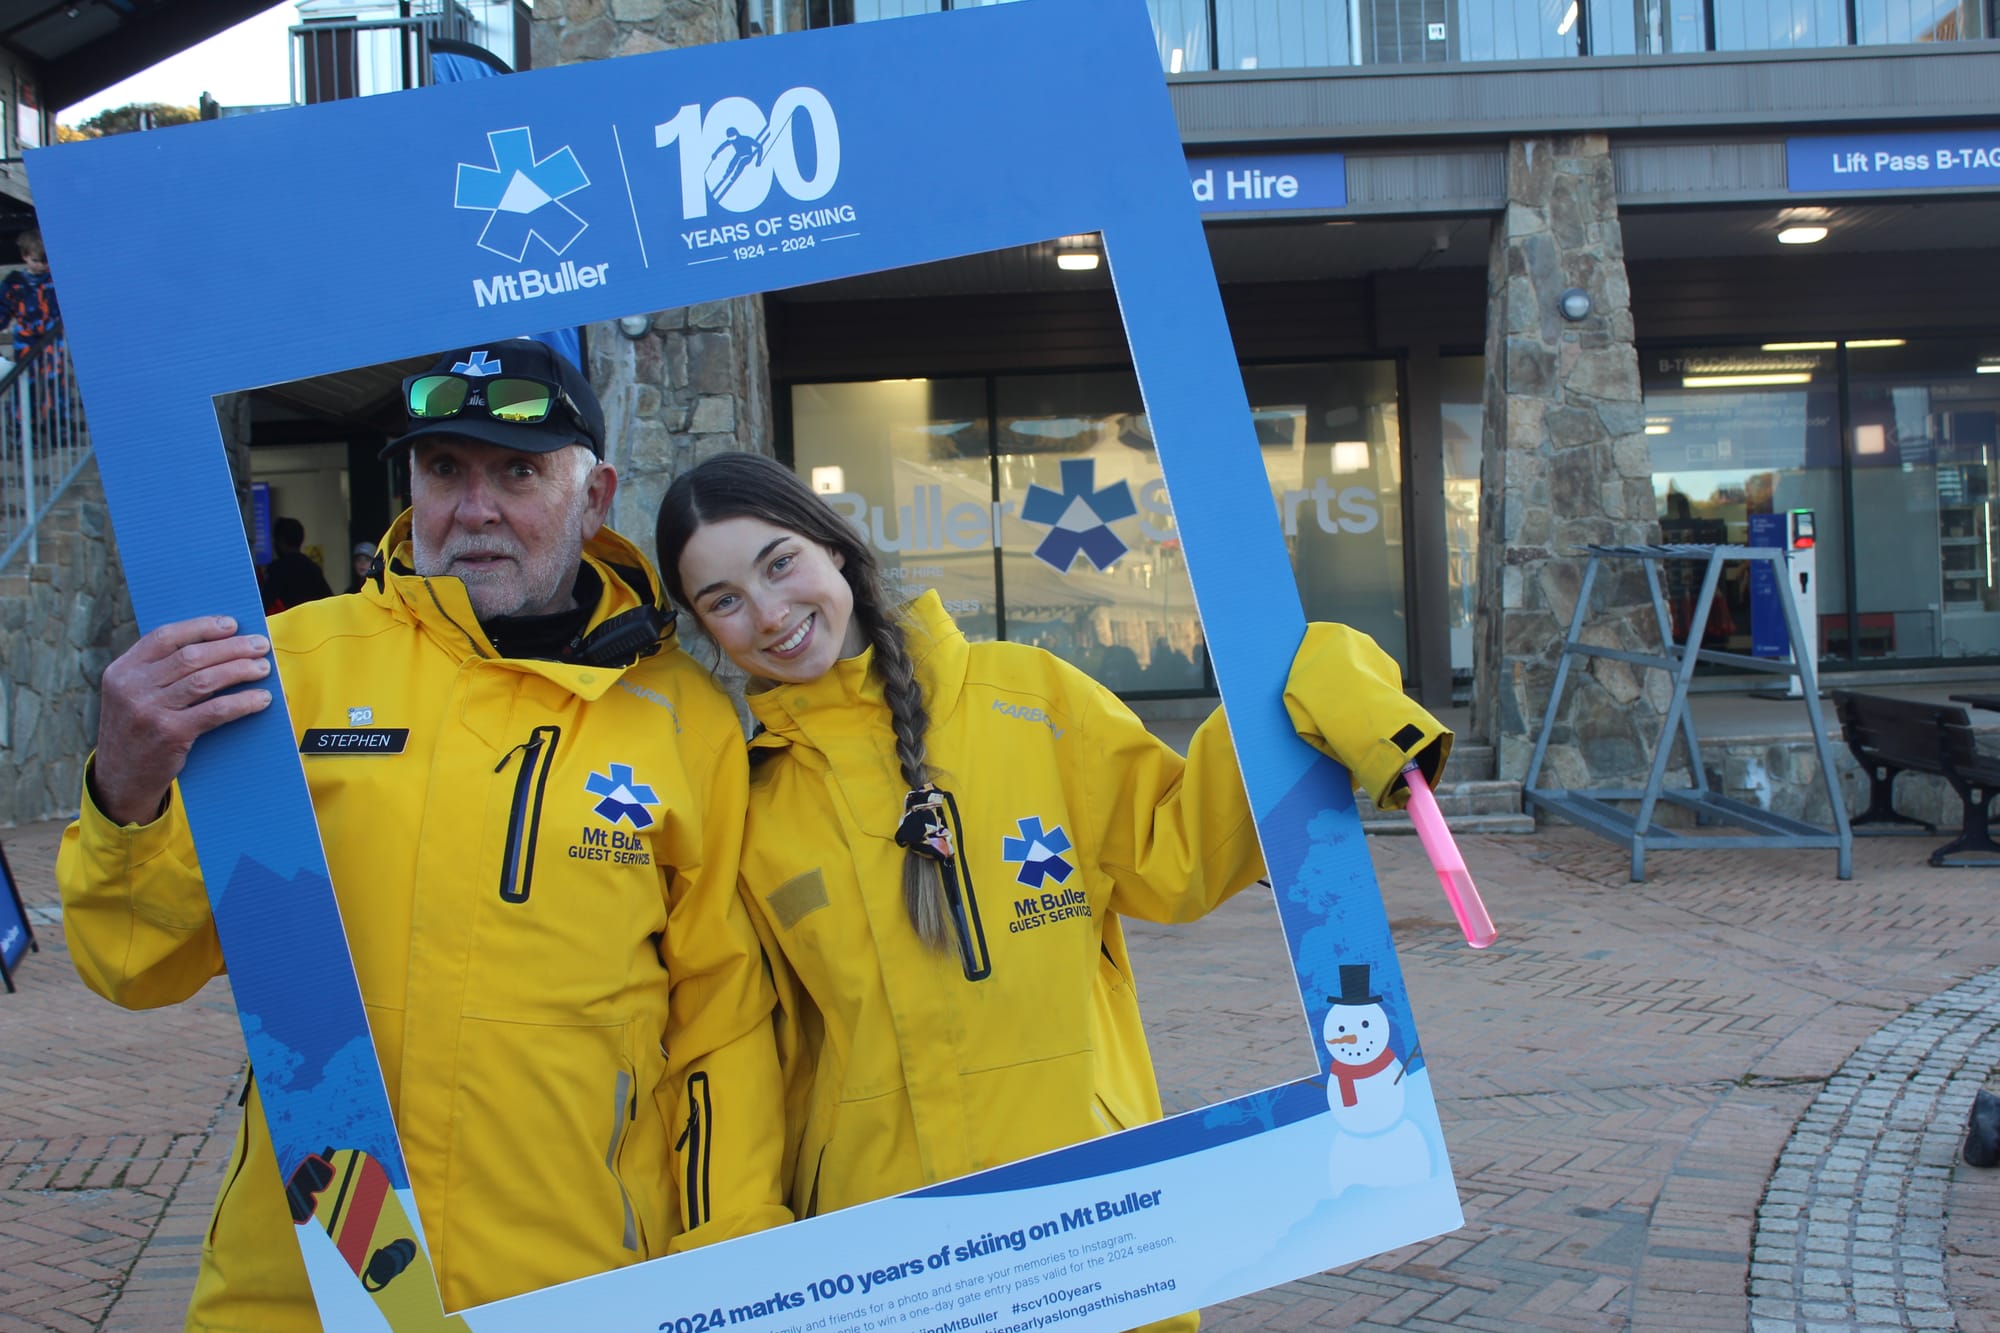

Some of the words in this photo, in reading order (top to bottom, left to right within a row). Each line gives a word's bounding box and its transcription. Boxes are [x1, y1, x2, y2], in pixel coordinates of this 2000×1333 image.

[655, 86, 841, 221] 100
[1832, 152, 1869, 173] Lift
[1874, 152, 1930, 172] Pass
[1226, 169, 1299, 200] Hire
[681, 223, 750, 250] YEARS
[755, 217, 783, 237] OF
[788, 205, 857, 231] SKIING
[733, 244, 765, 261] 1924
[781, 235, 816, 252] 2024
[992, 698, 1065, 741] KARBON
[318, 734, 391, 747] STEPHEN
[583, 827, 608, 847] Mt
[569, 845, 611, 862] GUEST
[1014, 898, 1040, 918] Mt
[1040, 888, 1086, 911] Buller
[1009, 913, 1046, 933] GUEST
[658, 1308, 726, 1333] 2024
[728, 1291, 805, 1324] marks
[806, 1273, 854, 1302] 100
[857, 1258, 925, 1294] years
[927, 1245, 951, 1270] of
[954, 1229, 1027, 1262] skiing
[1028, 1220, 1060, 1241] on
[1060, 1207, 1095, 1232] Mt
[1095, 1189, 1162, 1222] Buller
[805, 1317, 826, 1332] and
[829, 1307, 868, 1325] friends
[869, 1302, 885, 1315] for
[888, 1302, 895, 1310] a
[897, 1290, 929, 1308] photo
[932, 1284, 952, 1297] and
[955, 1274, 985, 1291] share
[988, 1267, 1011, 1284] your
[1014, 1252, 1066, 1274] memories
[1068, 1246, 1080, 1258] to
[1081, 1231, 1137, 1255] Instagram.
[863, 1321, 875, 1332] to
[877, 1316, 897, 1328] win
[899, 1313, 907, 1321] a
[909, 1300, 954, 1319] one-day
[957, 1291, 981, 1307] gate
[984, 1283, 1012, 1300] entry
[1014, 1274, 1040, 1291] pass
[1042, 1266, 1068, 1281] valid
[1070, 1261, 1085, 1273] for
[1087, 1256, 1105, 1268] the
[1108, 1246, 1134, 1263] 2024
[1137, 1237, 1177, 1254] season.
[1011, 1280, 1103, 1315] #scv100years
